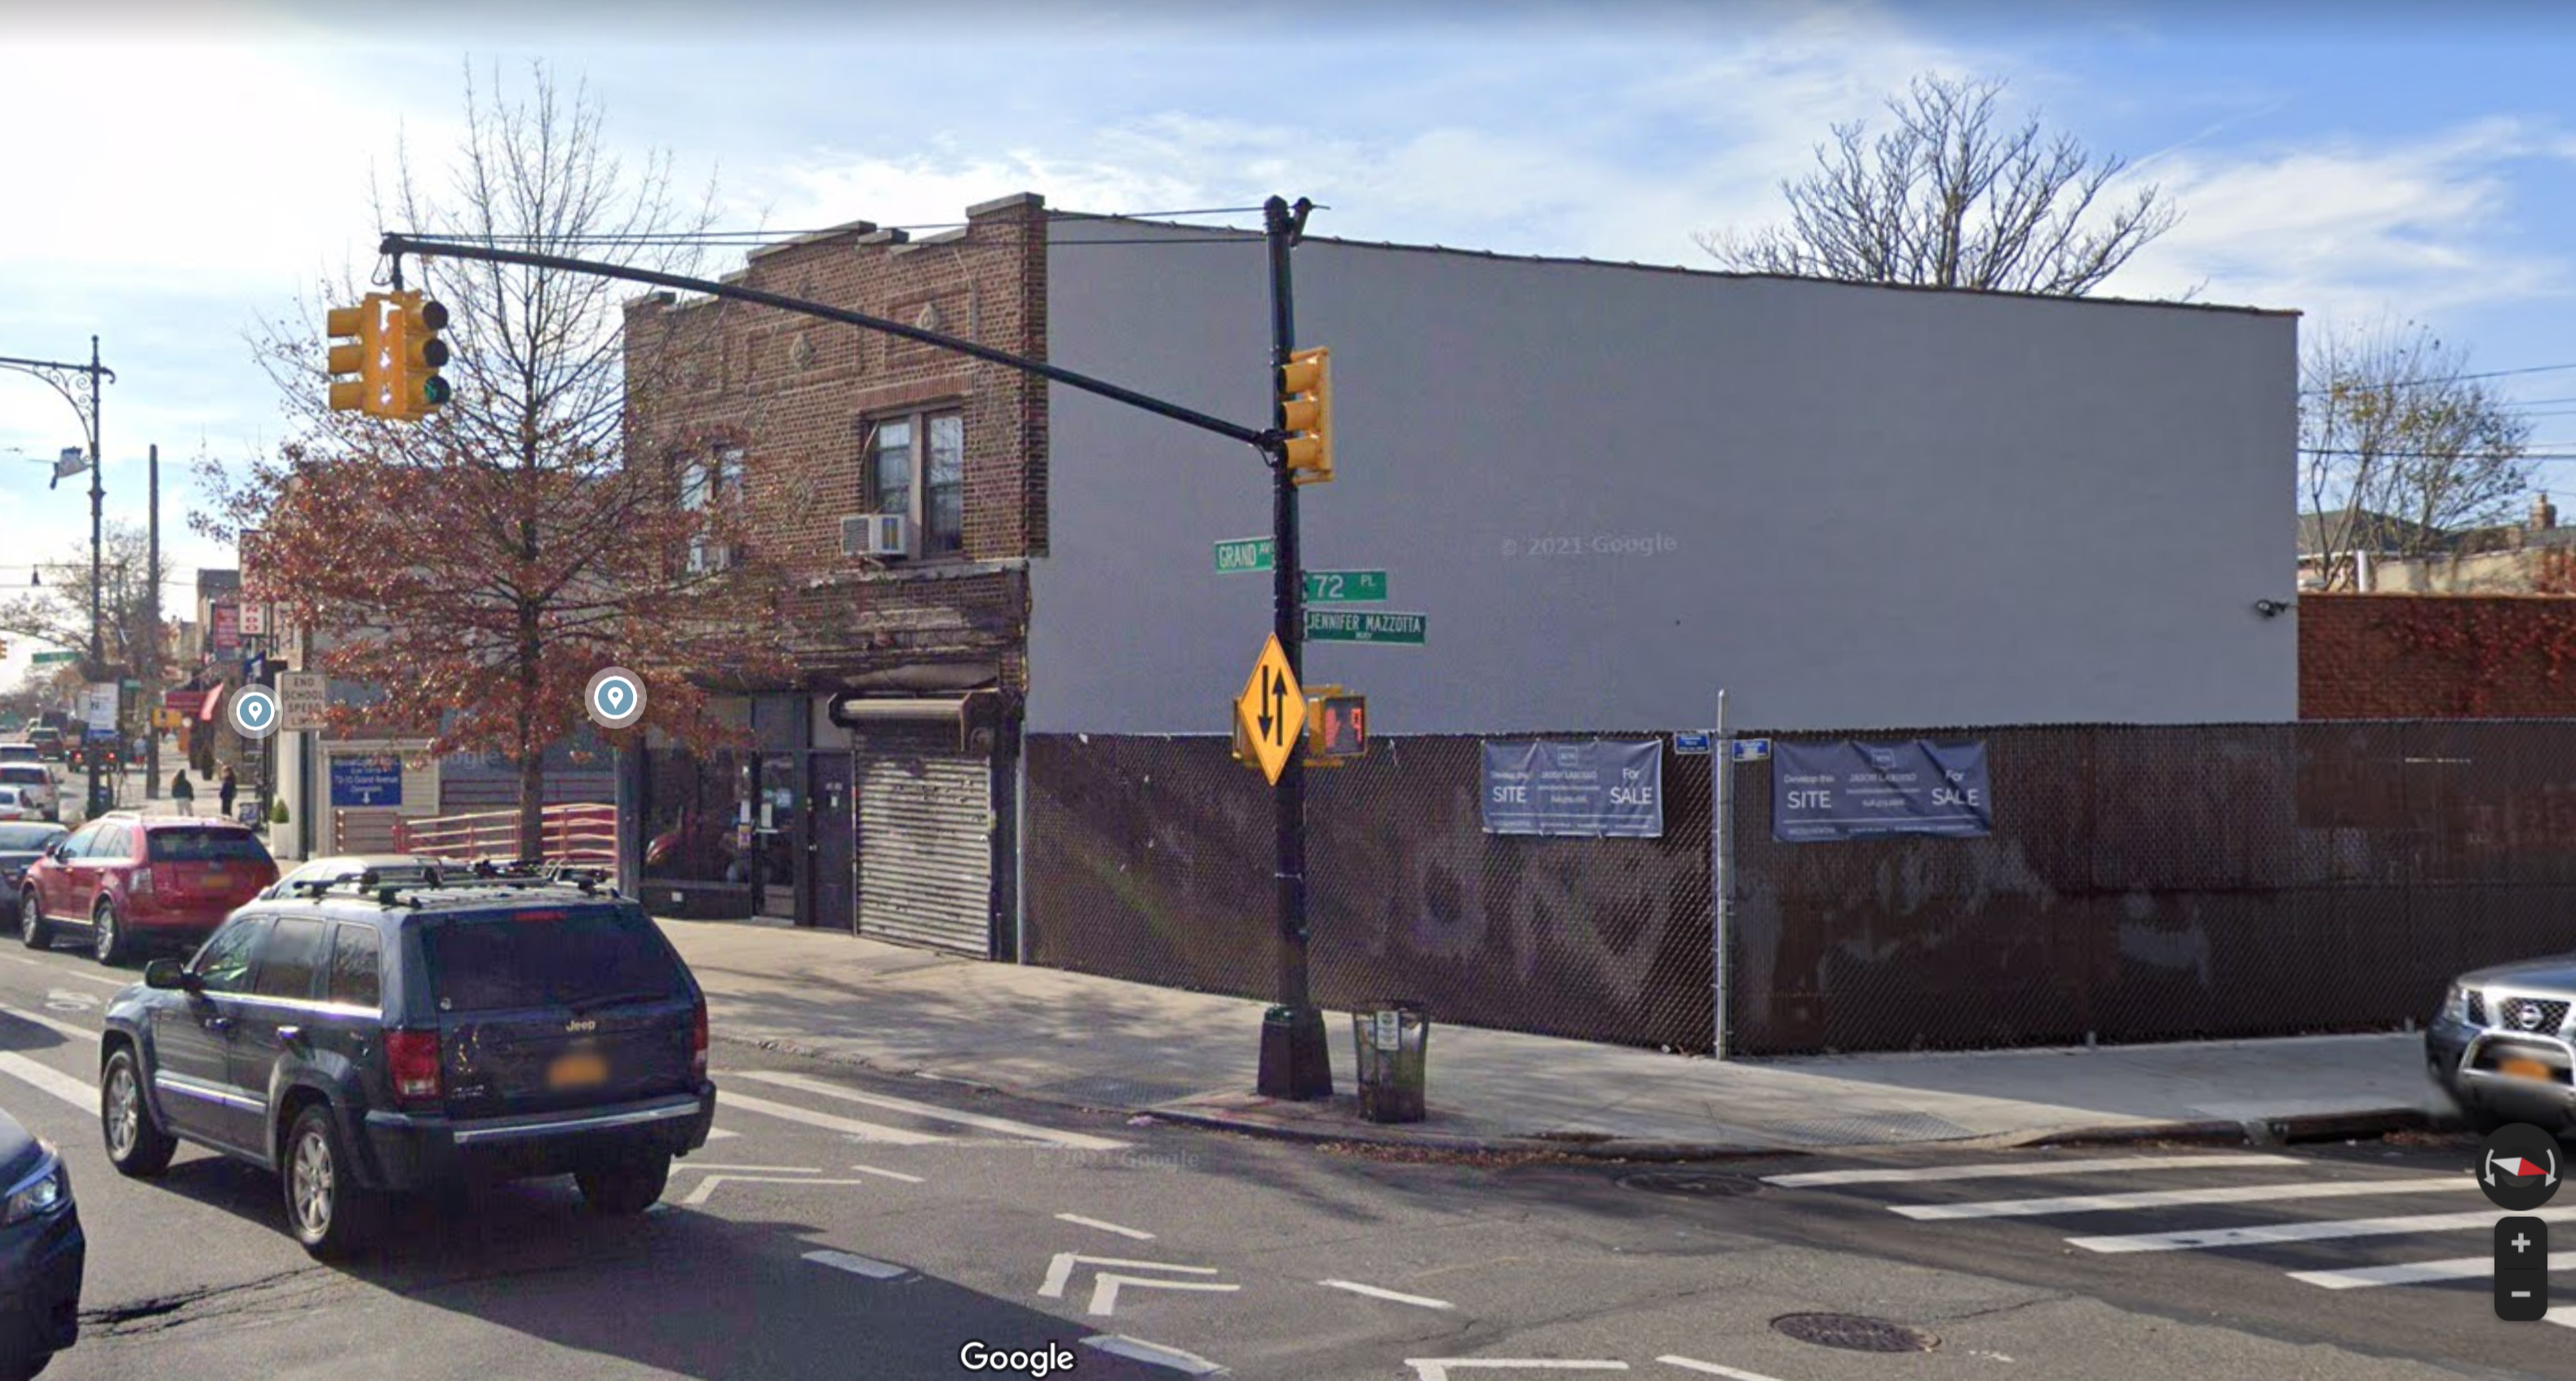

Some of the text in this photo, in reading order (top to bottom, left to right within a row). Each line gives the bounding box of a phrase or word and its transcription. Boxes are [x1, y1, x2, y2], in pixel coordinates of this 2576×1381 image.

[1219, 544, 1256, 568] GRAND
[1312, 574, 1374, 598] 72 PL
[1308, 613, 1421, 633] JENNIFER MAZZOTTA
[294, 677, 314, 688] END
[284, 690, 323, 700] SCHOOL
[1622, 768, 1640, 779] For
[1945, 769, 1965, 782] For
[1493, 786, 1527, 803] SITE
[1609, 786, 1653, 805] SALE
[1787, 790, 1831, 808] SITE
[1932, 788, 1980, 807] SALE
[565, 1020, 596, 1033] Jeep
